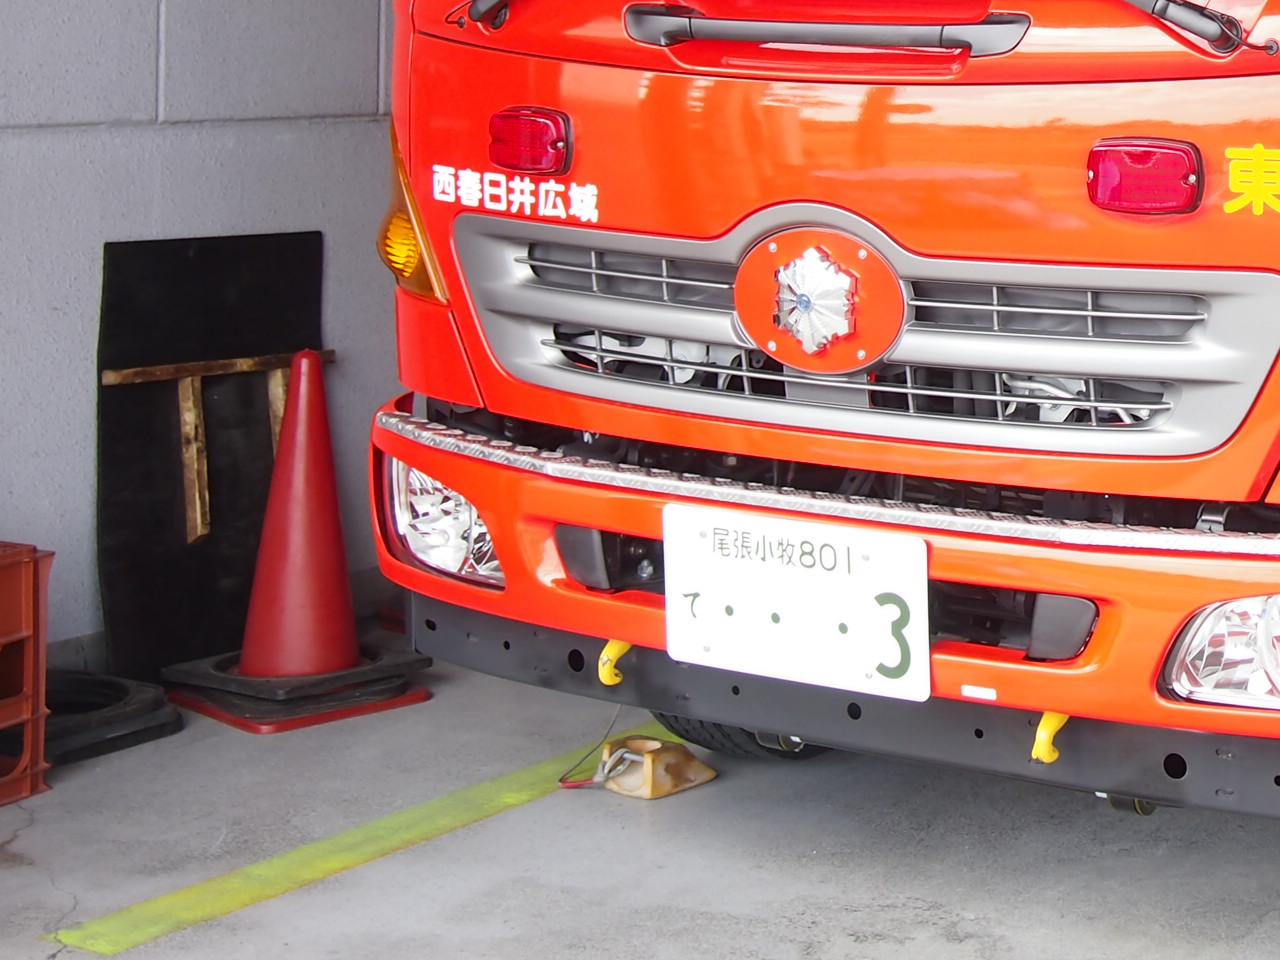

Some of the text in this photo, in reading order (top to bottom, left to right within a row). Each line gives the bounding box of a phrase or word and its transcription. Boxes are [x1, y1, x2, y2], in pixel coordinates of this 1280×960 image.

[432, 163, 600, 224] 西春日井広域
